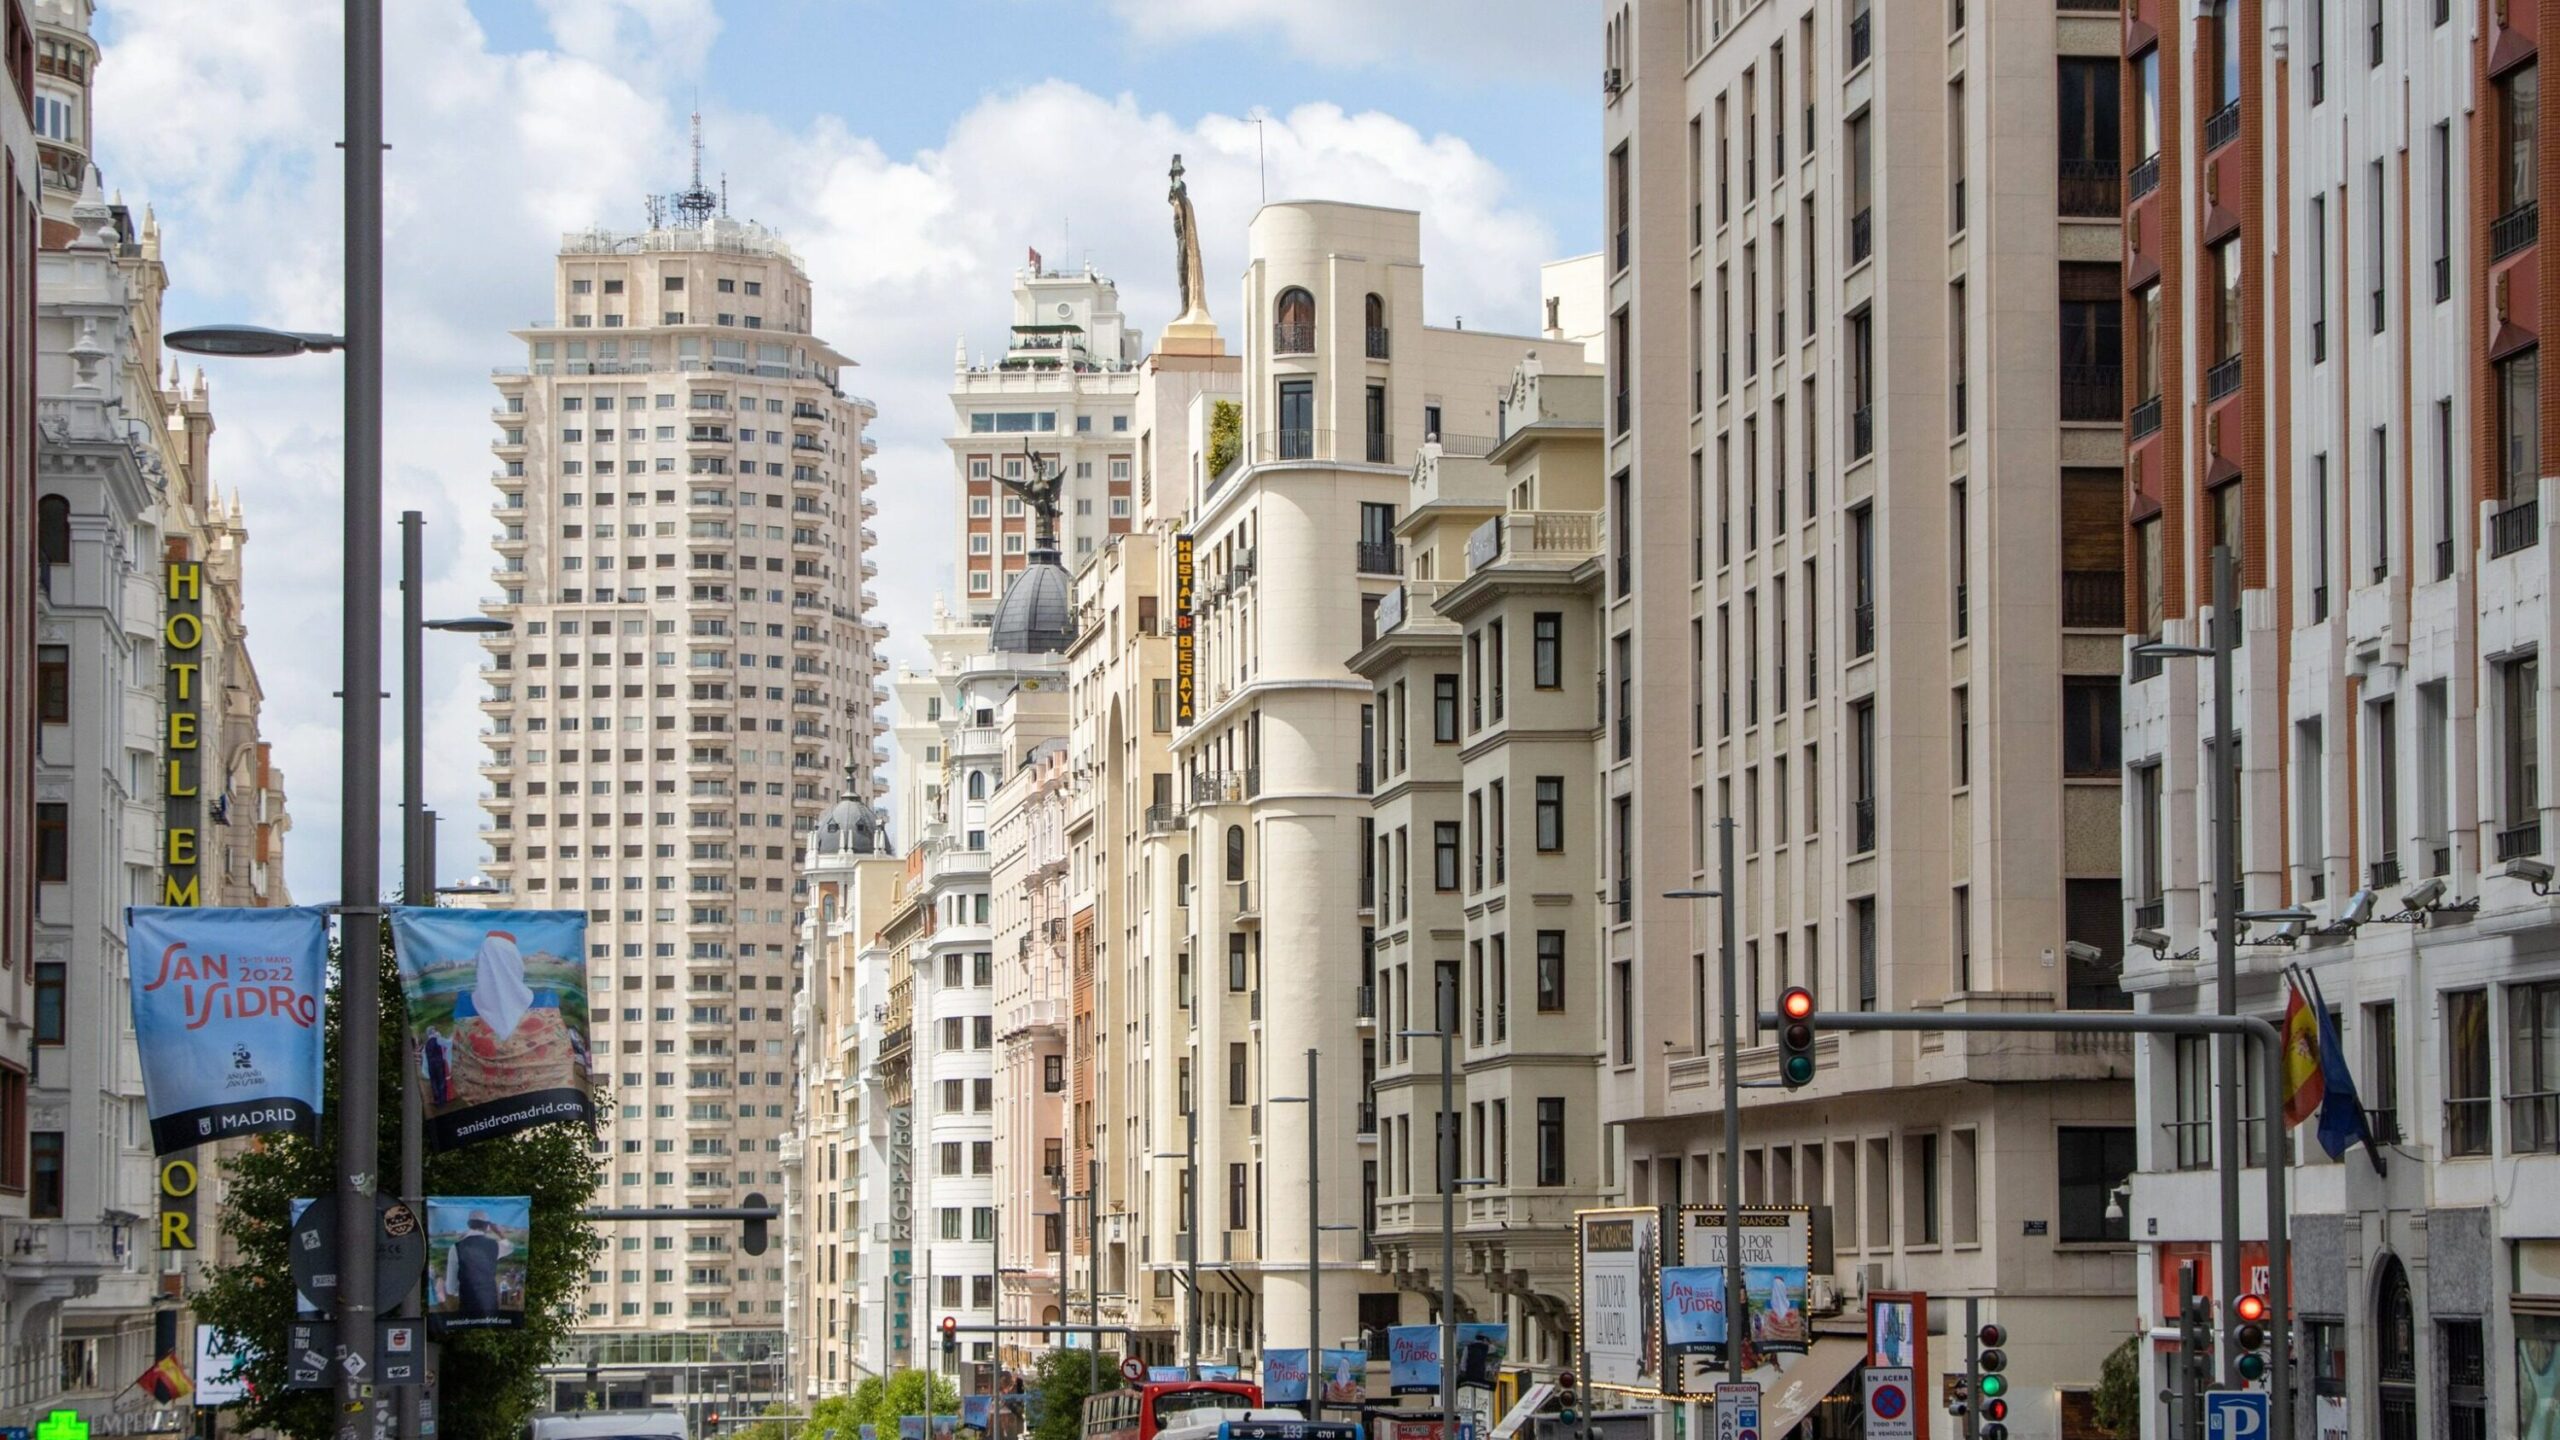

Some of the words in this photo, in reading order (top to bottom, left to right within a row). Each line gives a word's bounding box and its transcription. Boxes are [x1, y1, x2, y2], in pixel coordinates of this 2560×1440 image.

[1178, 541, 1193, 609] HOSTAL
[166, 564, 202, 796] HOTEL
[1178, 636, 1193, 717] BESAYA
[144, 942, 228, 991] SAN
[266, 956, 292, 964] MAYO
[239, 966, 294, 982] 2022
[183, 982, 316, 1030] ISIDRO
[222, 1108, 296, 1129] MADRID
[456, 1102, 583, 1137] sanisidromadrid.com
[892, 1112, 912, 1241] SENATOR
[1699, 1216, 1720, 1226] LOS
[1601, 1223, 1632, 1249] MORANCOS
[1711, 1234, 1746, 1248] TOO
[1749, 1234, 1773, 1248] POR
[1711, 1249, 1726, 1262] LA
[1740, 1249, 1773, 1262] ATRIA
[2250, 1266, 2270, 1295] KF
[893, 1249, 911, 1350] HOTEL
[1666, 1281, 1693, 1300] SAN
[1679, 1297, 1723, 1315] ISIDRO
[1392, 1337, 1414, 1352] SAN
[1265, 1359, 1285, 1371] SAN
[1401, 1349, 1437, 1363] ISIDRO
[1274, 1370, 1306, 1383] ISIDRO
[1720, 1385, 1757, 1393] PRECAUCIÓN
[1283, 1425, 1303, 1439] 133
[1317, 1430, 1335, 1439] 4701
